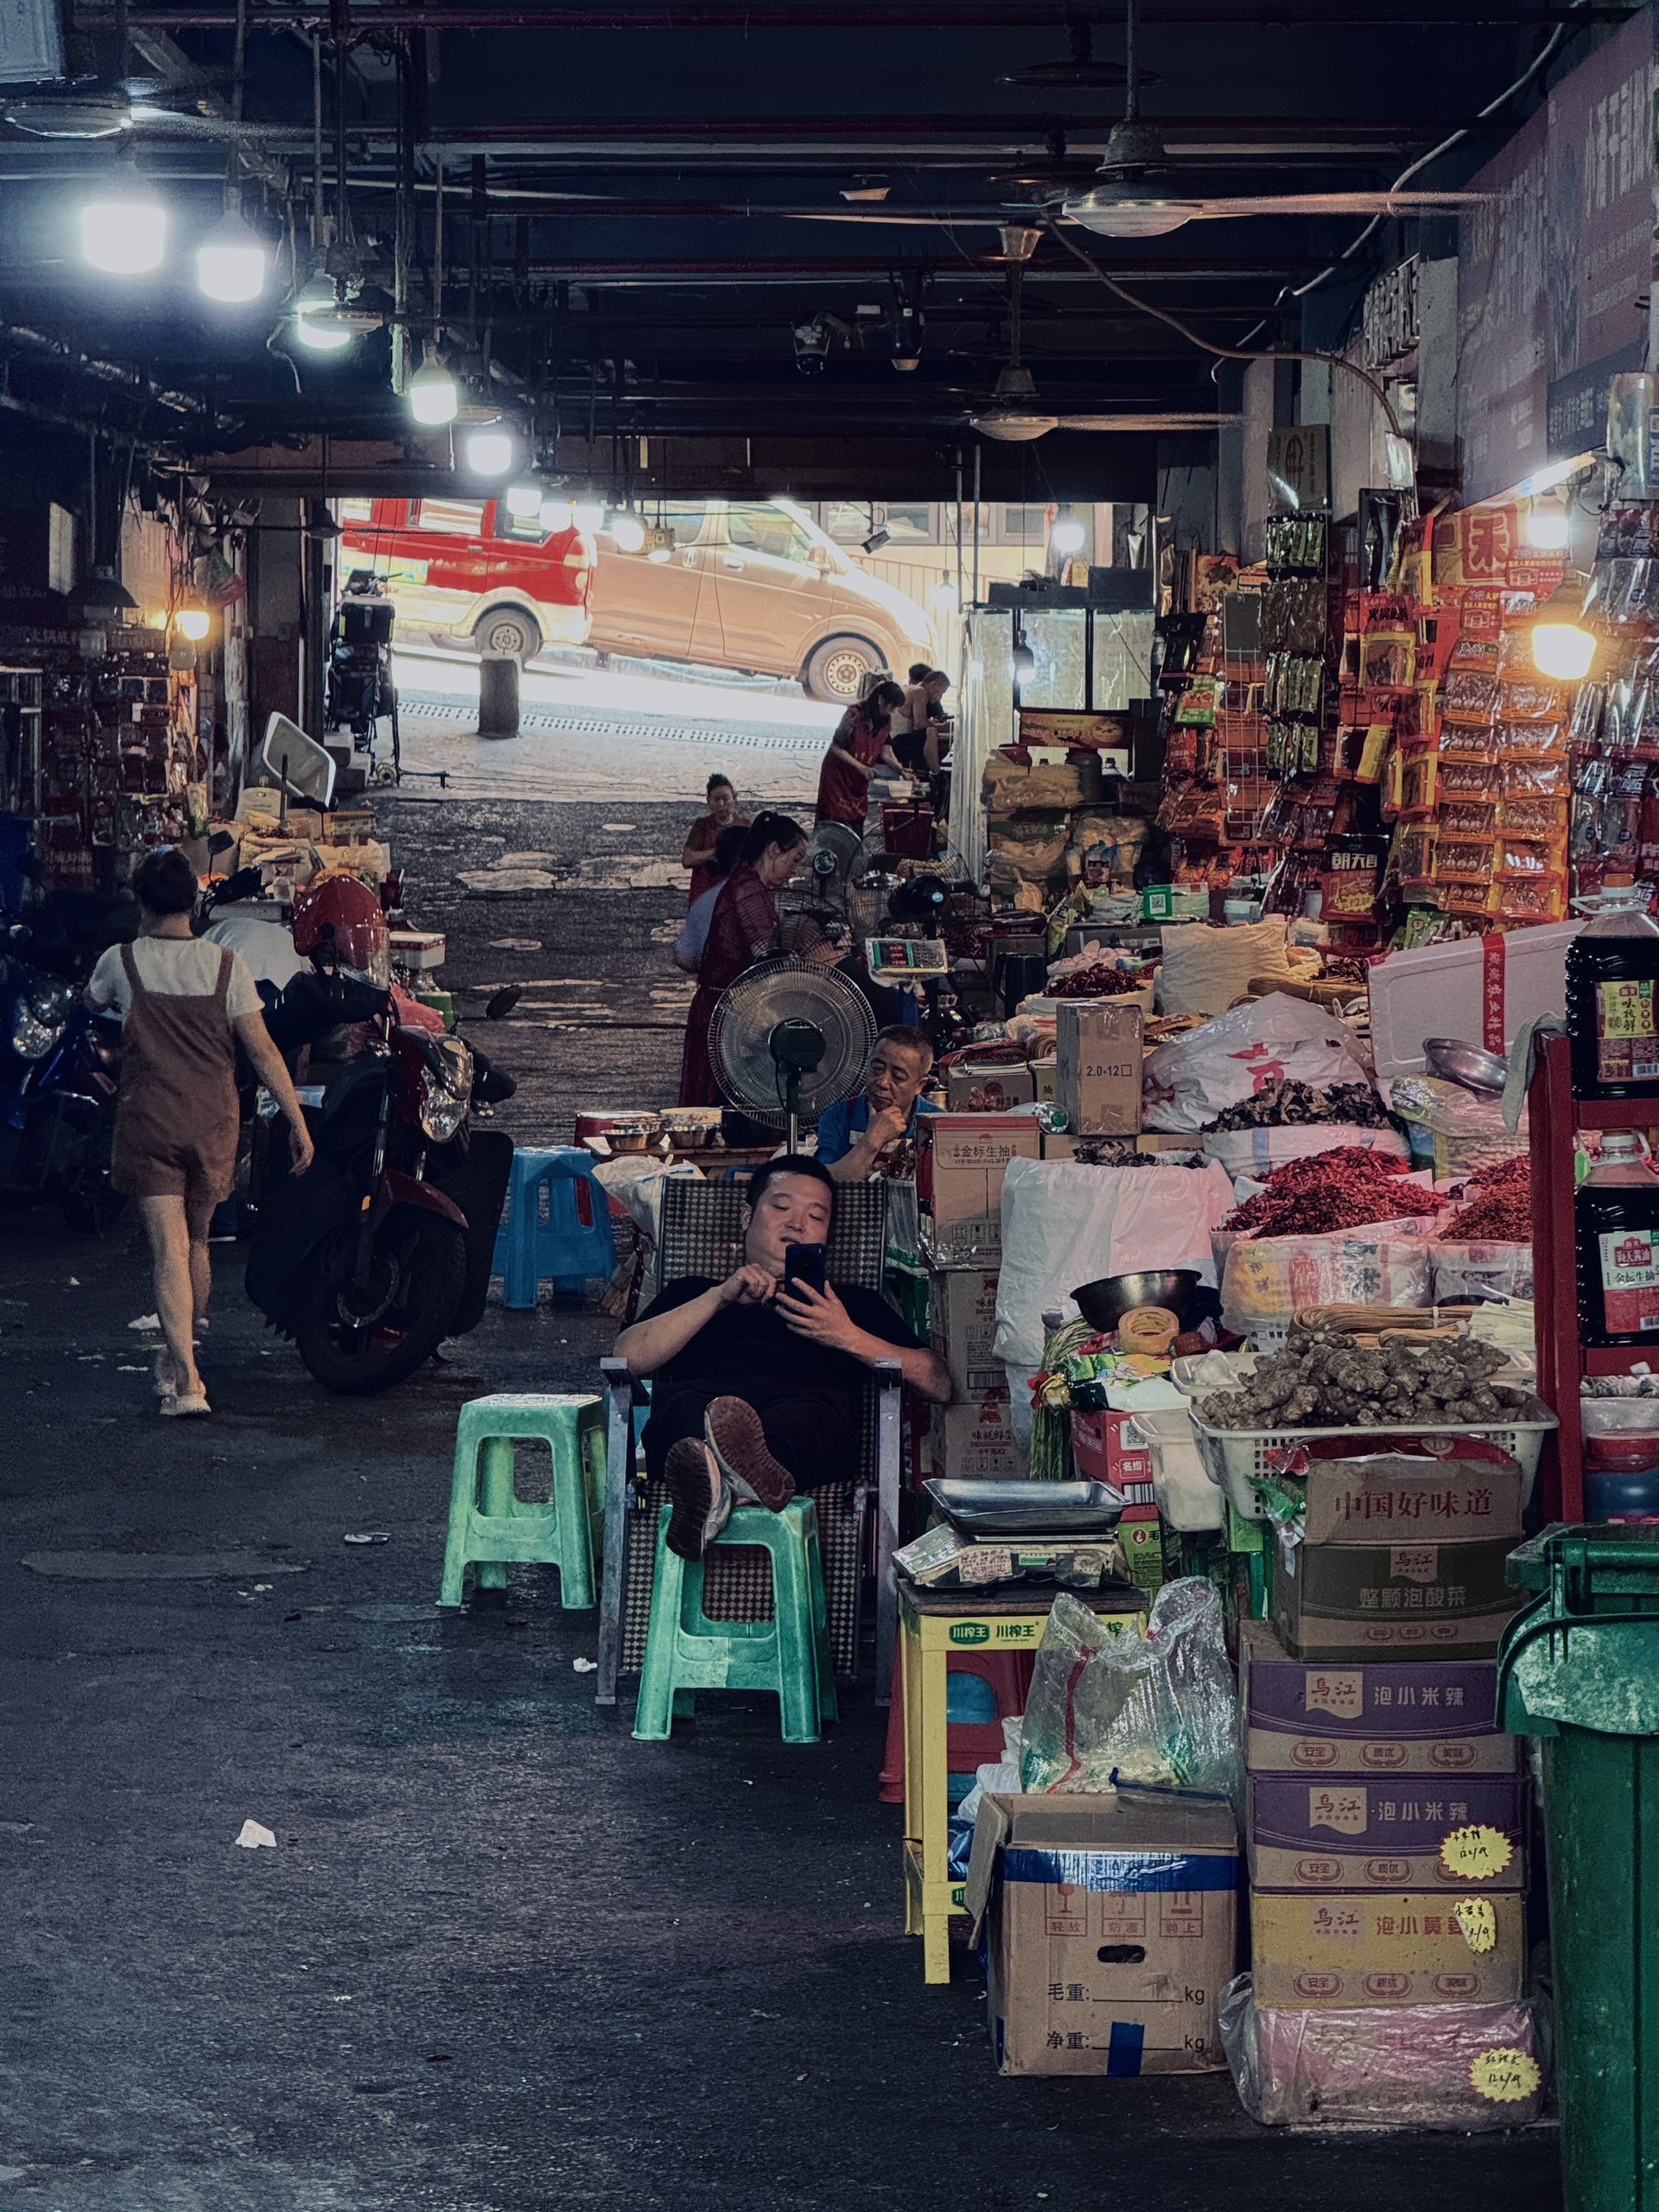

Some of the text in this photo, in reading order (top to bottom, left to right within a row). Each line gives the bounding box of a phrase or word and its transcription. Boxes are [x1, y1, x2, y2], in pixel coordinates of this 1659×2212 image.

[961, 1145, 1011, 1158] 金标生抽
[1335, 1488, 1494, 1521] 中国好味道
[1394, 1552, 1433, 1567] 乌江
[1358, 1586, 1468, 1610] 整颗泡酸菜
[952, 1626, 988, 1639] 川榨王
[996, 1624, 1036, 1638] 川榨王
[1312, 1677, 1357, 1696] 乌江
[1374, 1686, 1465, 1707] 泡小米辣
[1305, 1746, 1325, 1758] 安全
[1314, 1793, 1362, 1812] 乌江
[1378, 1801, 1469, 1821] 泡小米辣
[1313, 1907, 1360, 1927] 乌江
[1050, 1921, 1081, 1933] 轻放
[1166, 1923, 1196, 1934] 向上
[1047, 1982, 1205, 2005] 毛重: kg
[1046, 2031, 1205, 2053] 净重: kg
